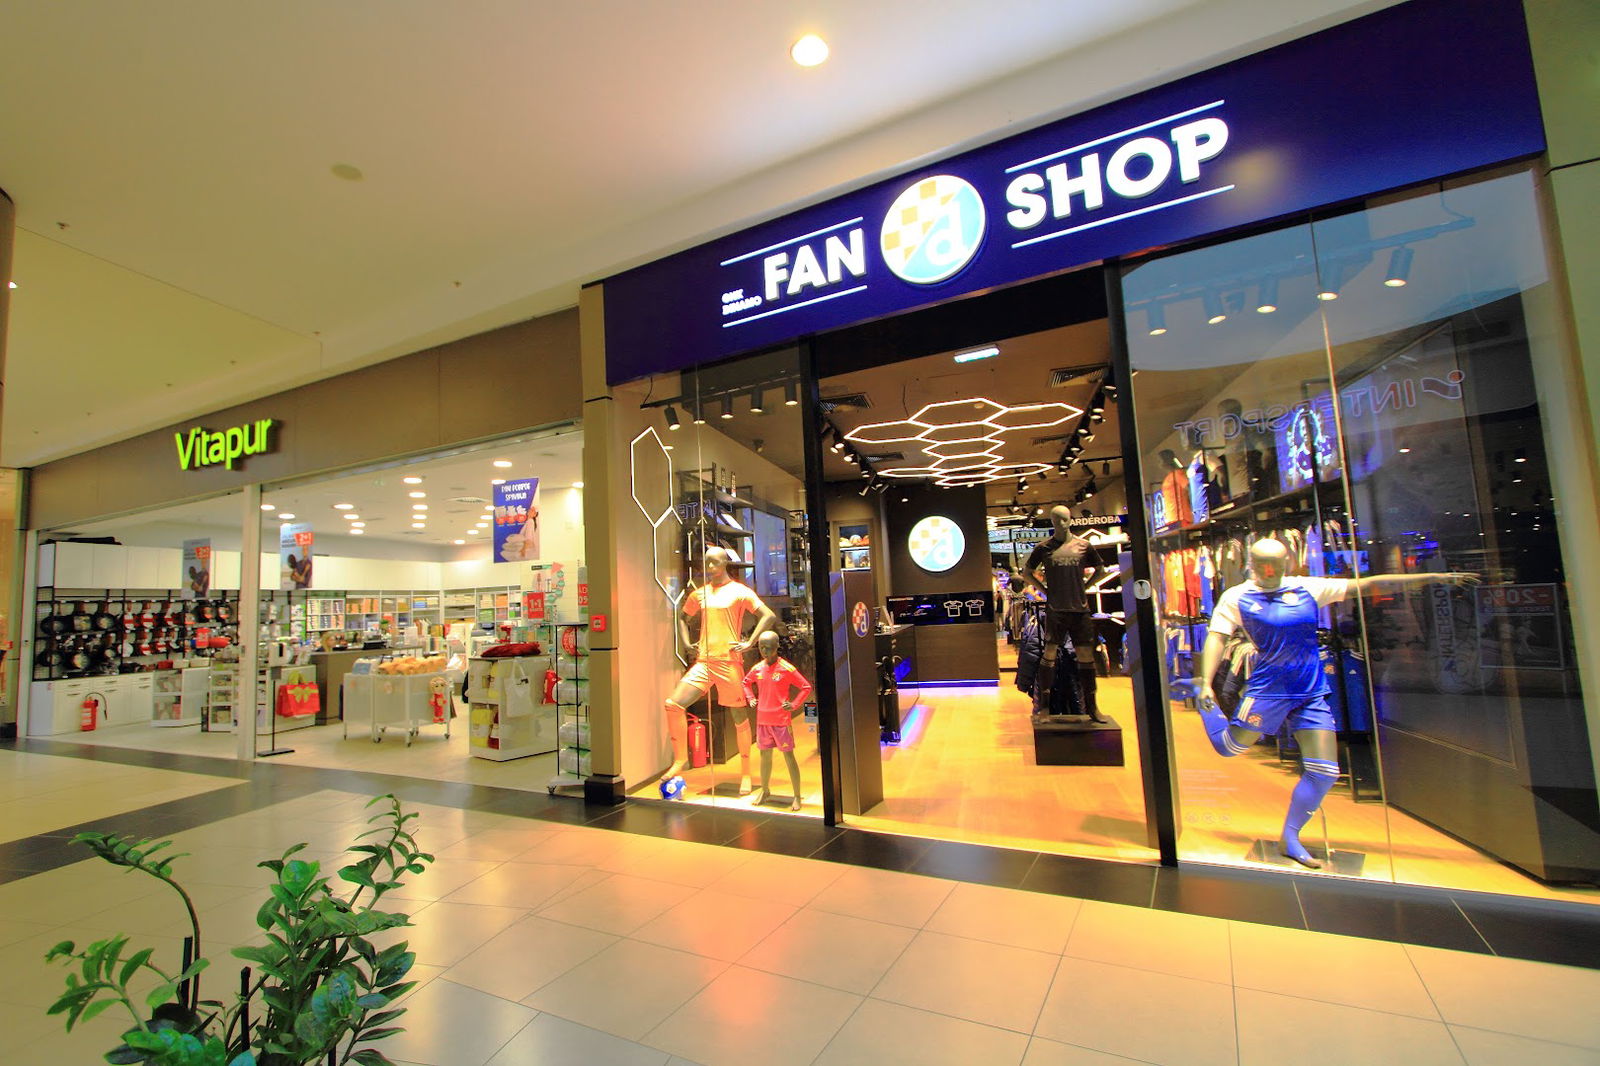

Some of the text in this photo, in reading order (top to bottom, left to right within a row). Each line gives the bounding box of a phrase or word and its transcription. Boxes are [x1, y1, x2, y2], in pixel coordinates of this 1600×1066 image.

[764, 117, 1229, 301] FAN SHOP
[175, 418, 272, 470] Vitapur
[1070, 516, 1121, 526] ARDEROBA
